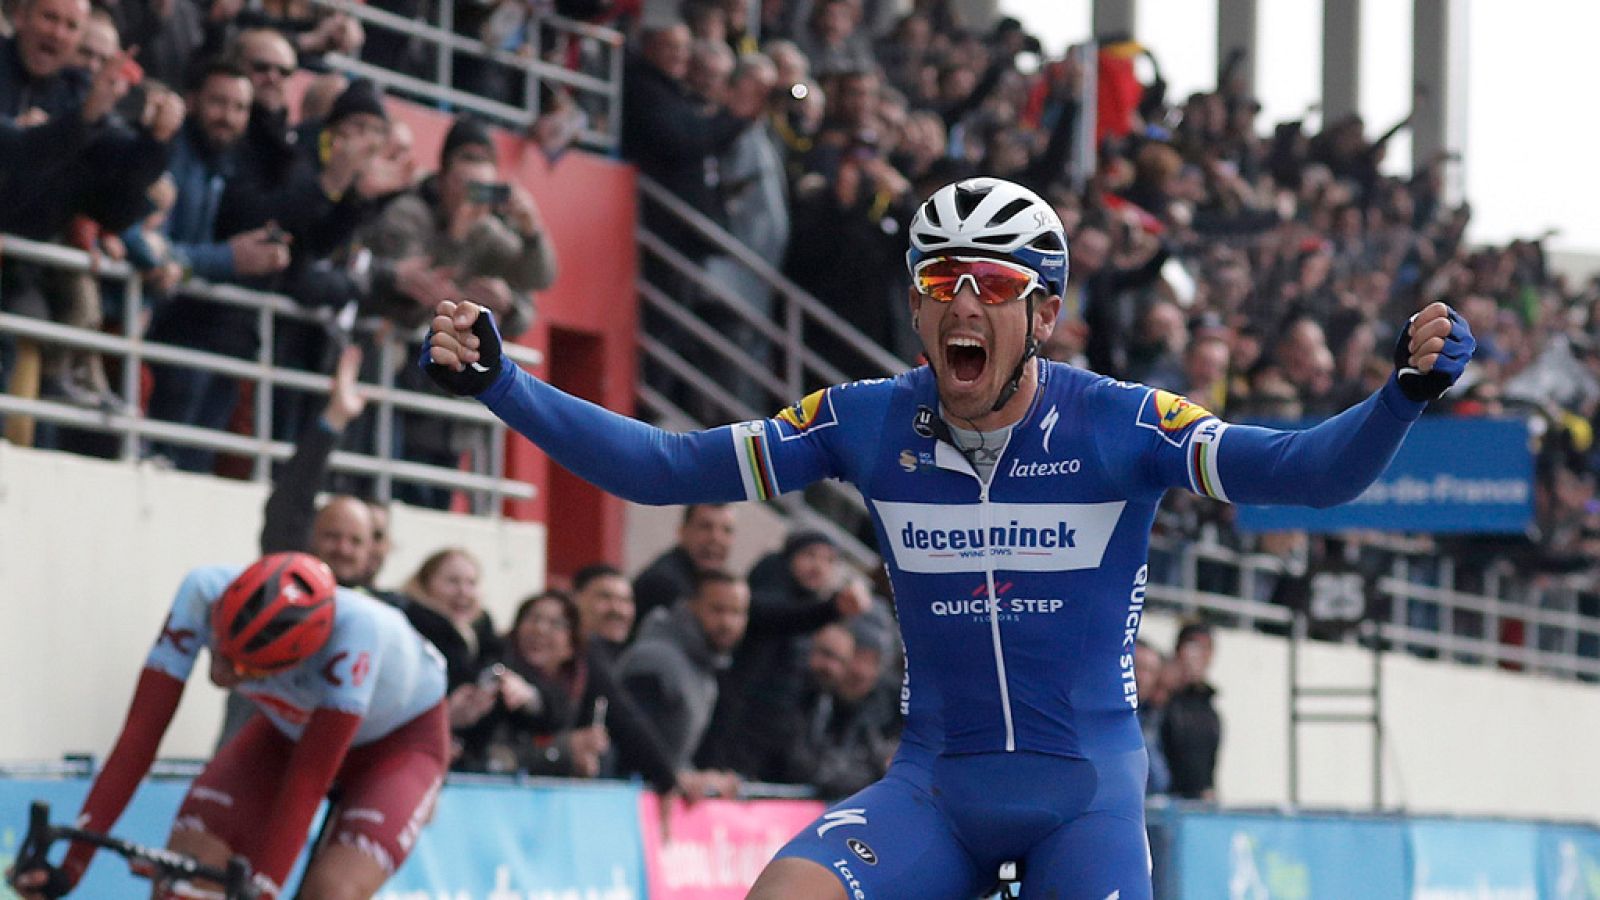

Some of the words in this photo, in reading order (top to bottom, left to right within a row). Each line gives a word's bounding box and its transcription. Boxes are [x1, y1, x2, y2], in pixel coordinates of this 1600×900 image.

[1008, 457, 1081, 478] latexco
[902, 520, 1076, 549] deceuninck
[931, 598, 1002, 616] QUICK
[1010, 598, 1064, 613] STEP
[1123, 563, 1148, 647] QUICK
[1120, 654, 1138, 711] STEP
